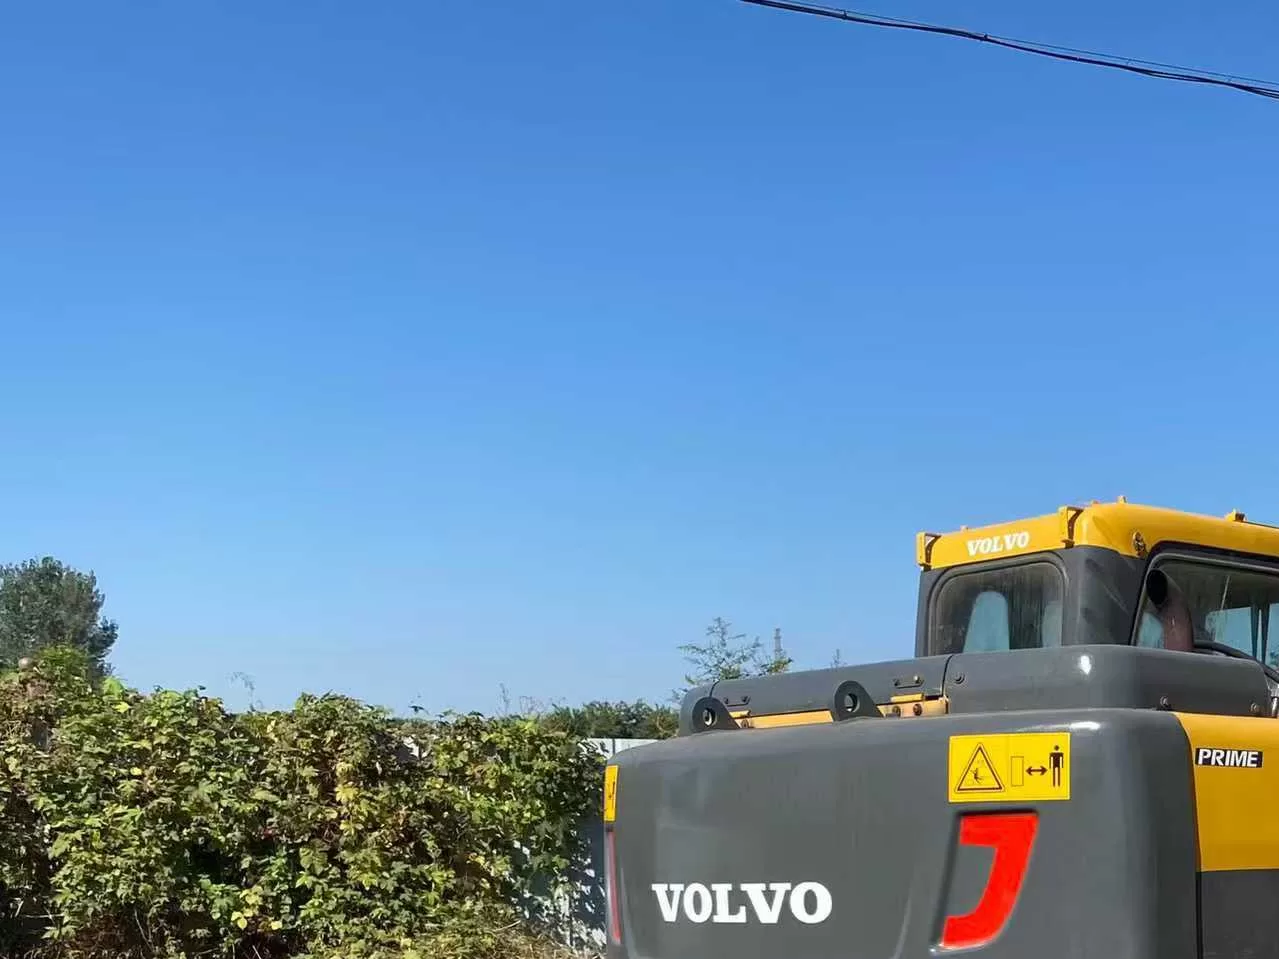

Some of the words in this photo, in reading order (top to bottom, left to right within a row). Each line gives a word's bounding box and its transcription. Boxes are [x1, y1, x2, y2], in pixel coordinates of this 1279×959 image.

[967, 531, 1030, 557] VOLVO
[1198, 748, 1259, 768] PRIME
[651, 881, 833, 924] VOLVO
